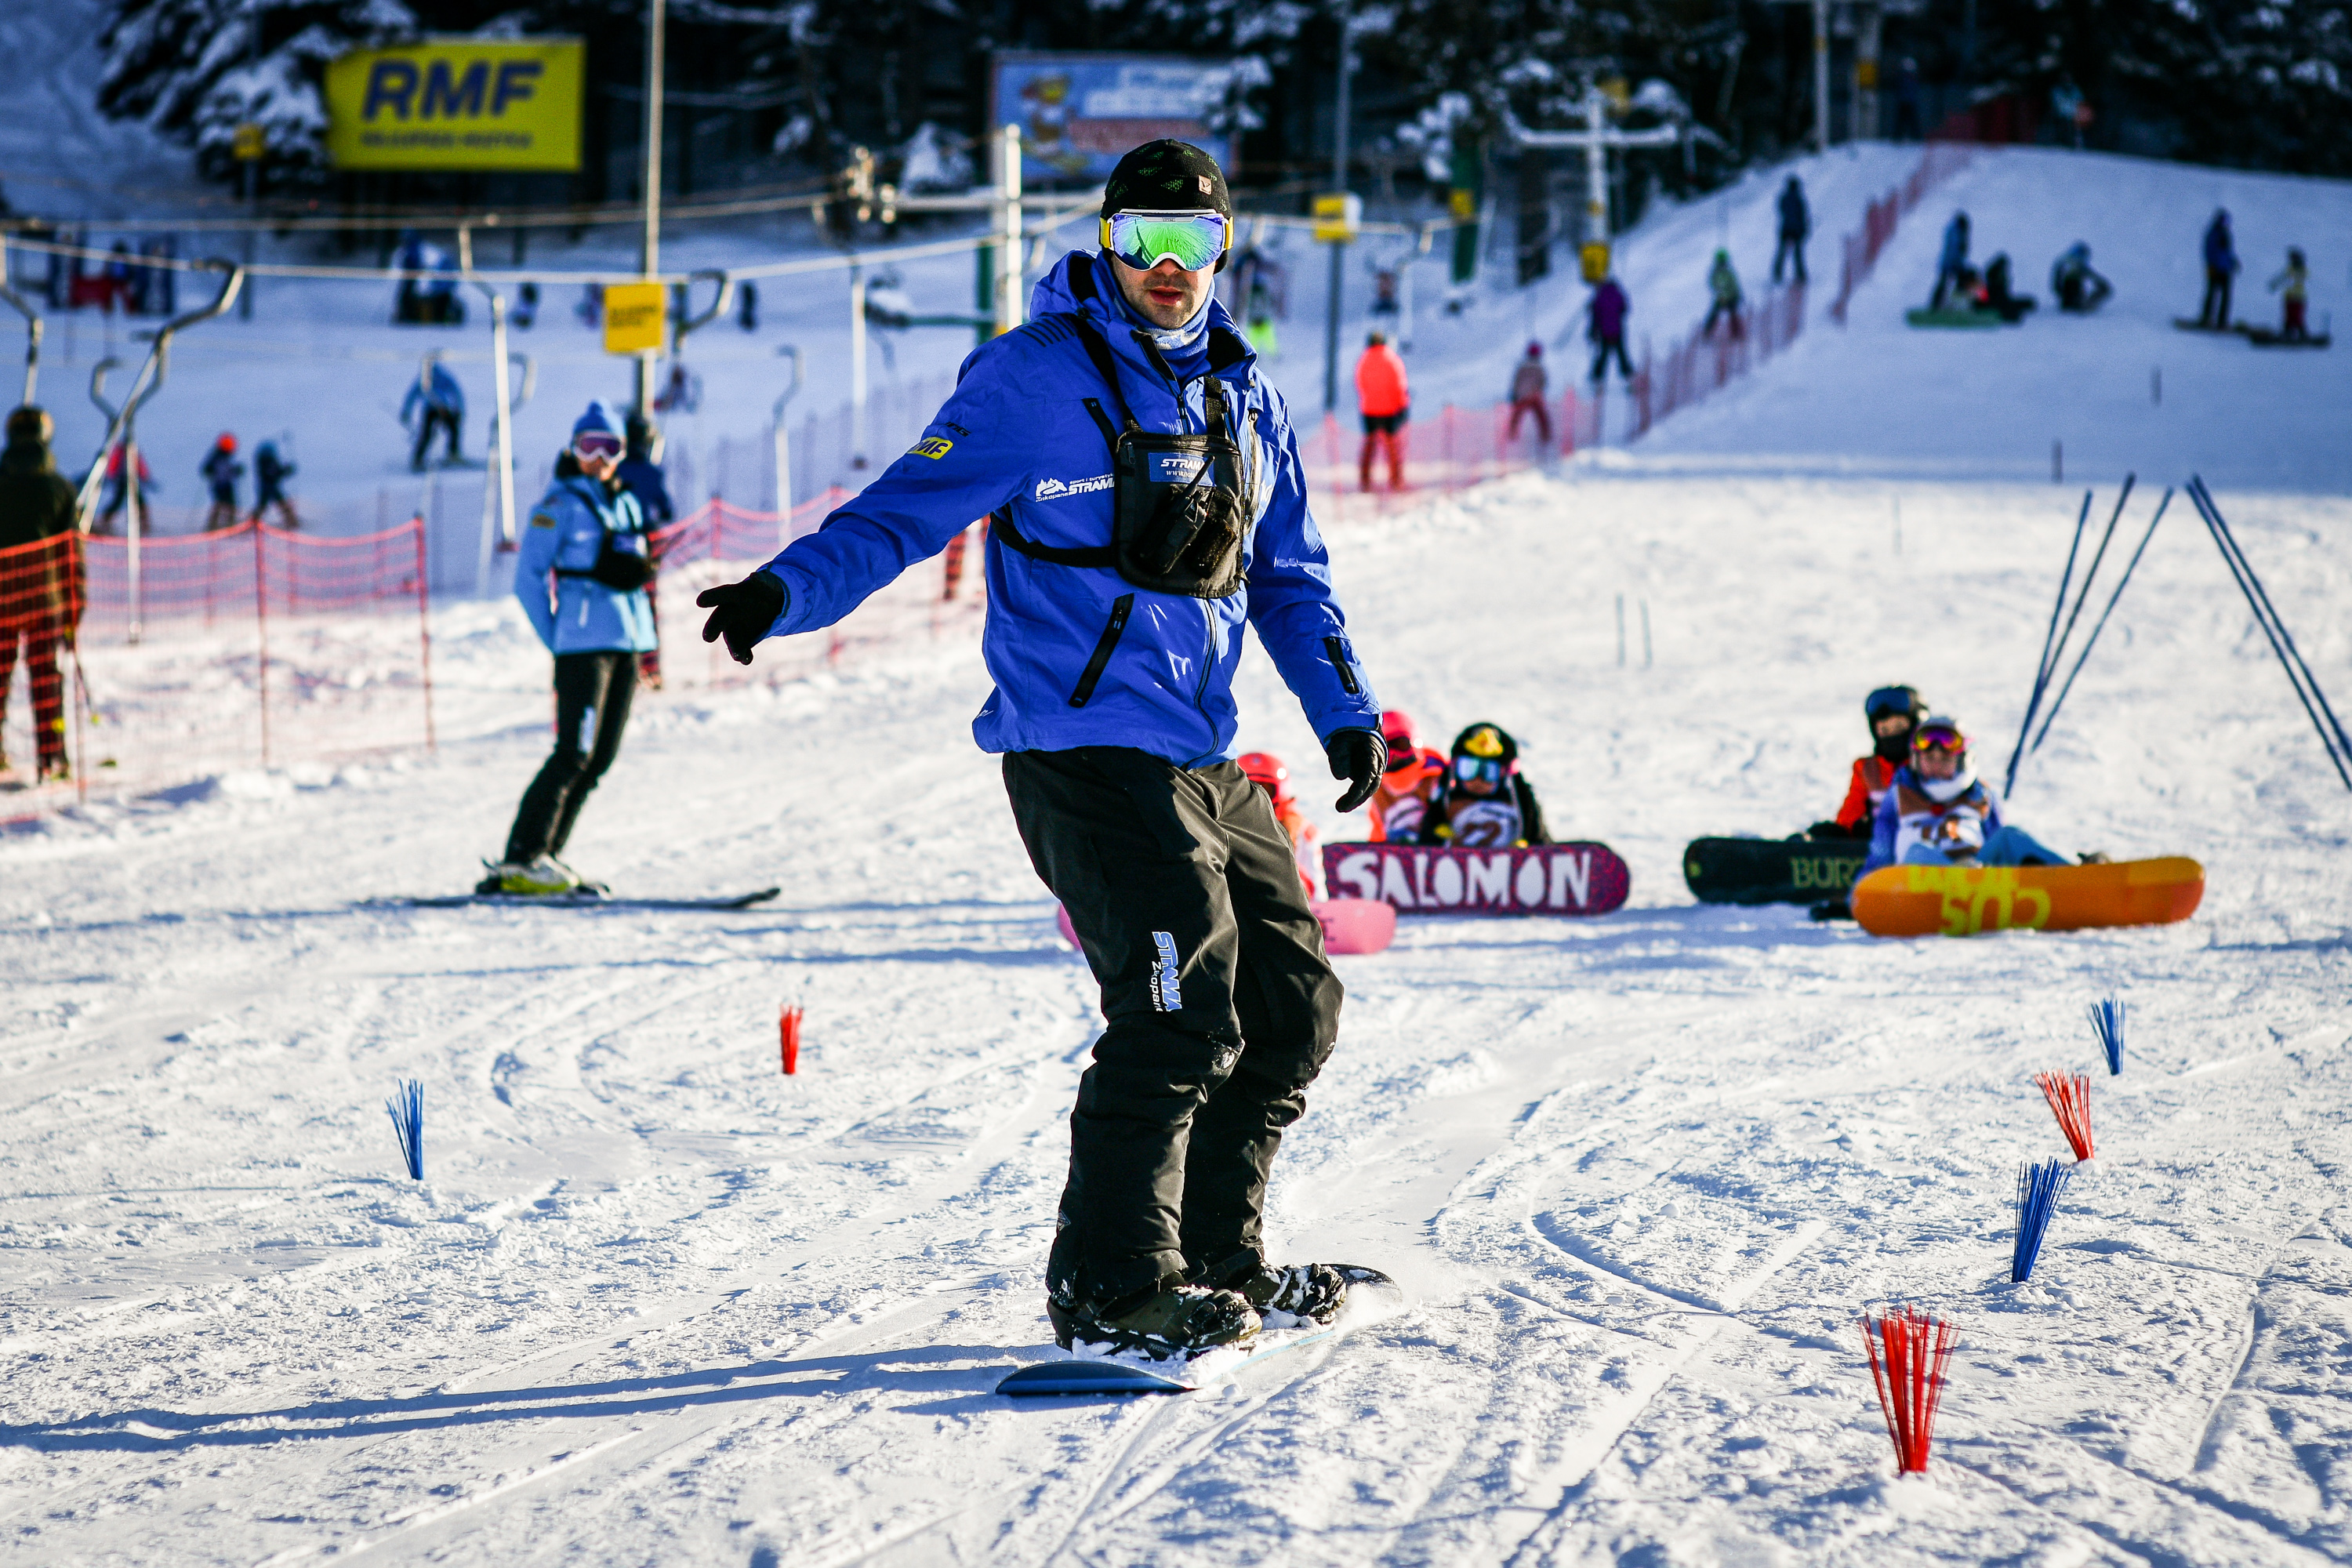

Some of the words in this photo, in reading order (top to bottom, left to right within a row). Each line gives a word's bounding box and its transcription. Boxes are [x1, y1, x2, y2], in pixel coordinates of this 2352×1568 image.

[362, 57, 546, 121] RMF
[1337, 851, 1592, 908] SALOMON
[1791, 857, 1865, 889] BUR
